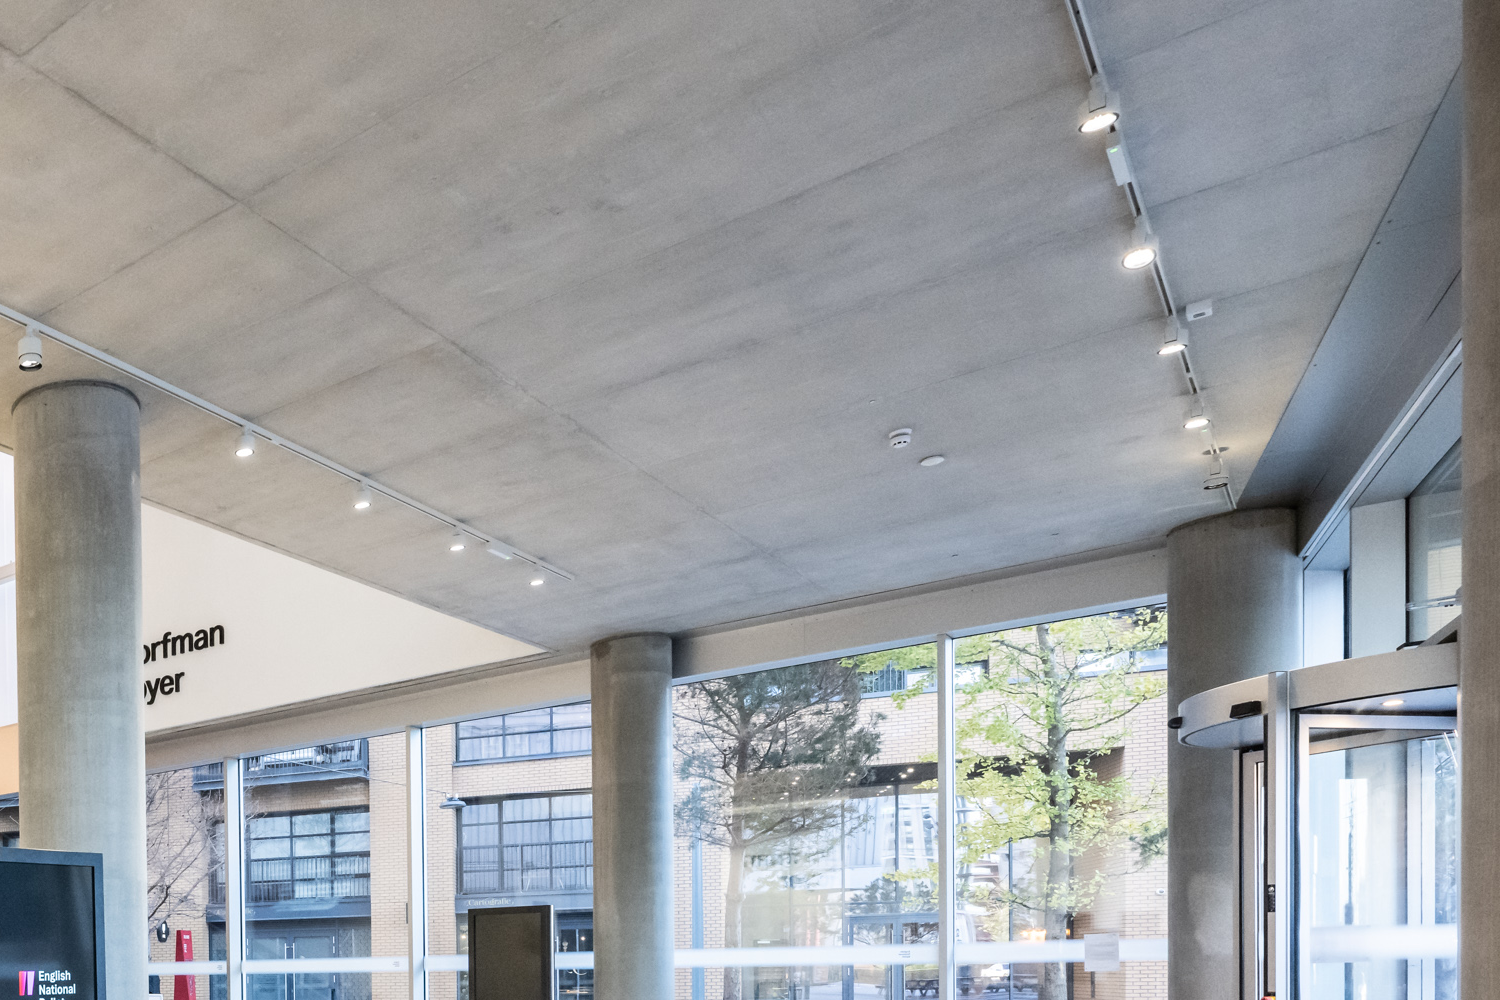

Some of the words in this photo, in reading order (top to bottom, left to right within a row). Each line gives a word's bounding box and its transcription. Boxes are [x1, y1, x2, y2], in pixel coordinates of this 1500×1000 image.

[143, 671, 185, 706] yer
[38, 970, 72, 983] English
[38, 984, 76, 996] National
